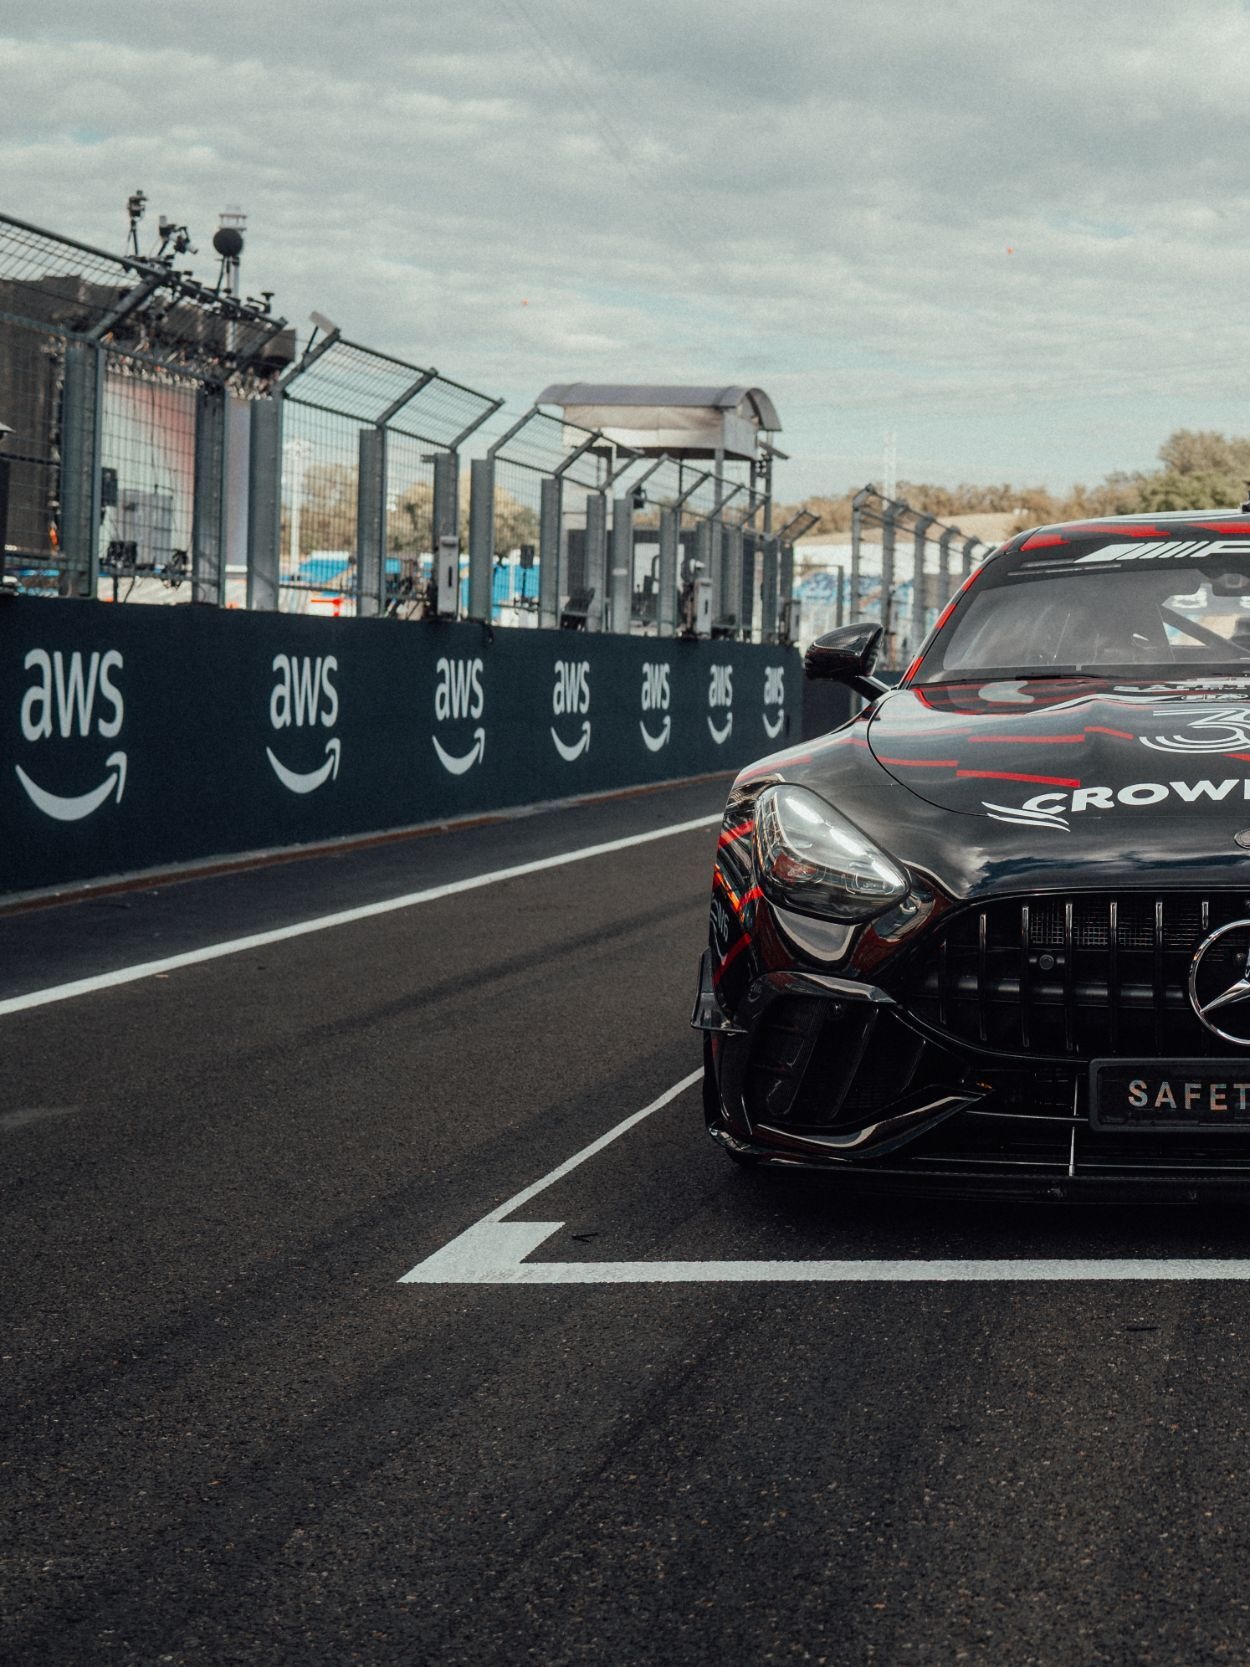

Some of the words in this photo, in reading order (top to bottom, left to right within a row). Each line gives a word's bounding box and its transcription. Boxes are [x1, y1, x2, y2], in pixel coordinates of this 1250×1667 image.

[20, 648, 124, 742] aws
[269, 654, 340, 729] aws
[434, 657, 484, 720] aws
[552, 660, 590, 714] aws
[641, 662, 671, 710] aws
[708, 664, 733, 707] aws
[763, 666, 785, 704] aws
